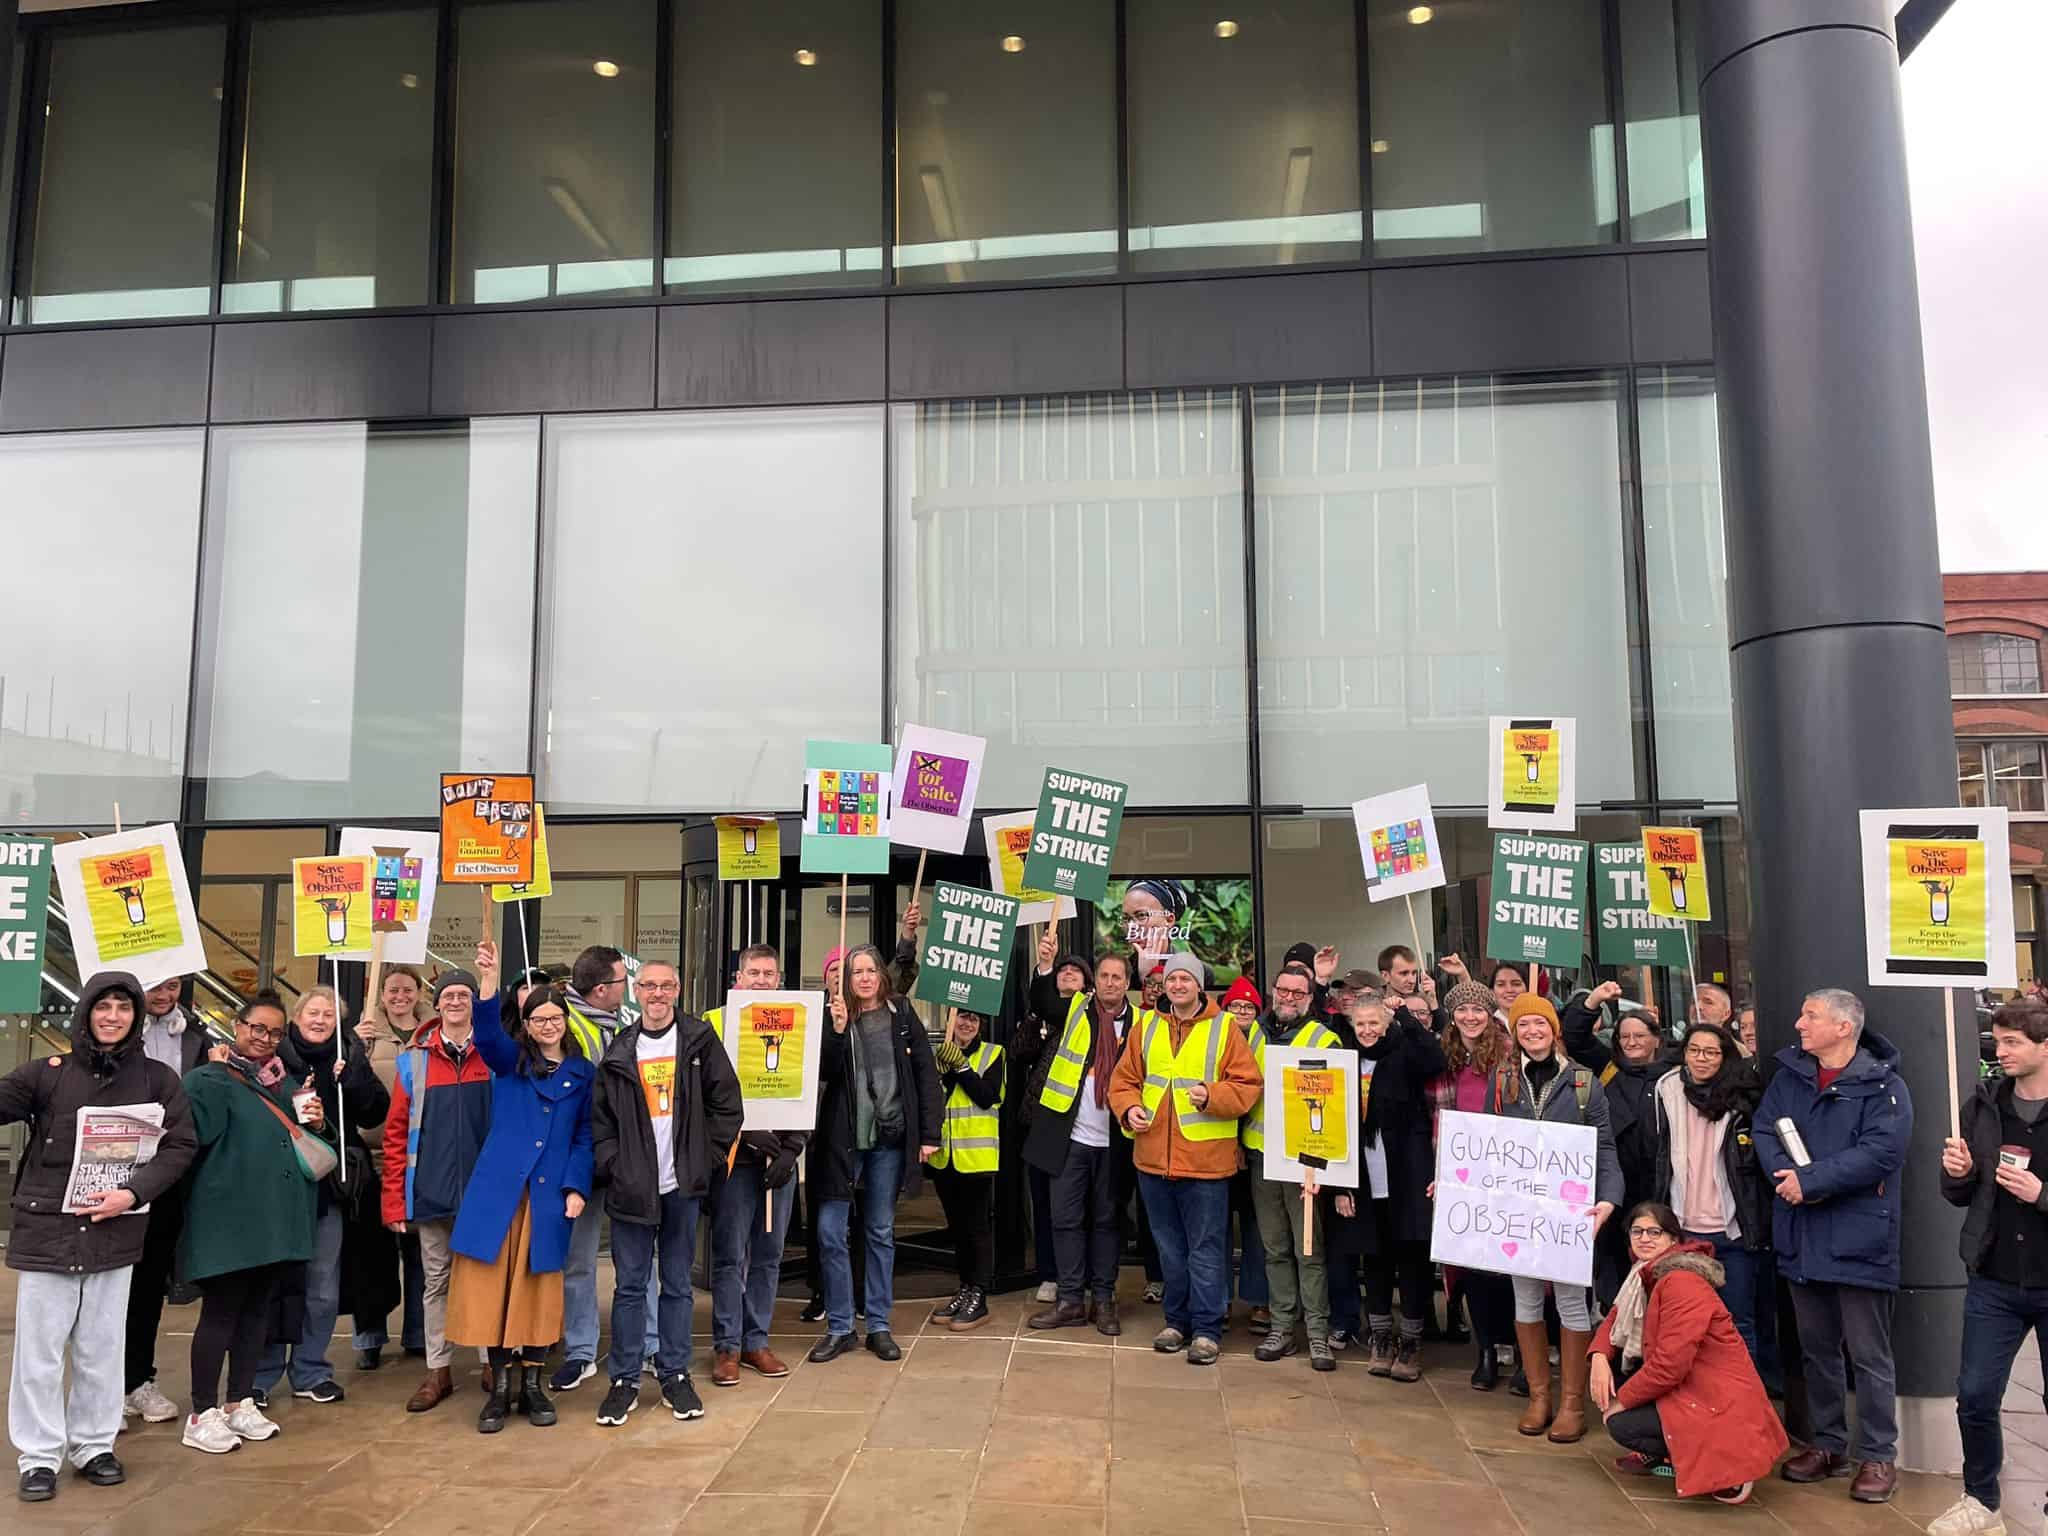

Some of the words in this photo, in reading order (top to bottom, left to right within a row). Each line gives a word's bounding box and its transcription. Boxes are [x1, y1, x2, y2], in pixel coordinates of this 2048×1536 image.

[918, 770, 944, 786] for
[1048, 773, 1123, 802] SUPPORT
[1051, 797, 1111, 838] THE
[1659, 835, 1680, 844] Save
[459, 846, 499, 856] Guardian
[1034, 832, 1110, 867] STRIKE
[1499, 838, 1583, 863] SUPPORT
[1664, 844, 1681, 854] The
[1921, 848, 1948, 858] Save
[1653, 851, 1696, 861] Observer
[110, 858, 134, 869] Save
[457, 864, 475, 873] The
[476, 864, 518, 873] Observer
[1925, 858, 1949, 867] The
[116, 866, 135, 875] The
[317, 864, 344, 875] Save
[1056, 868, 1077, 880] NUJ
[1911, 865, 1963, 875] Observer
[103, 870, 150, 886] Observer
[321, 874, 345, 883] The
[1506, 863, 1574, 900] THE
[307, 881, 361, 893] Observer
[1608, 870, 1650, 900] TH
[938, 886, 1015, 917] SUPPORT
[1494, 901, 1580, 930] STRIKE
[942, 910, 1004, 952] THE
[1126, 921, 1191, 941] Buried
[1920, 929, 1941, 939] Keep
[1942, 930, 1956, 938] the
[1523, 935, 1547, 946] NUJ
[1634, 939, 1657, 948] NUJ
[1907, 936, 1925, 945] free
[1926, 938, 1948, 947] press
[1950, 936, 1968, 945] free
[926, 945, 1004, 981] STRIKE
[763, 1008, 782, 1017] Save
[767, 1016, 781, 1024] The
[754, 1022, 793, 1031] Observer
[1450, 1132, 1594, 1180] GUARDIANS
[79, 1163, 104, 1176] STOP
[76, 1173, 130, 1185] IMPERIALIST
[1482, 1174, 1507, 1190] OF
[1511, 1178, 1548, 1196] THE
[1448, 1201, 1590, 1252] OBSERVER
